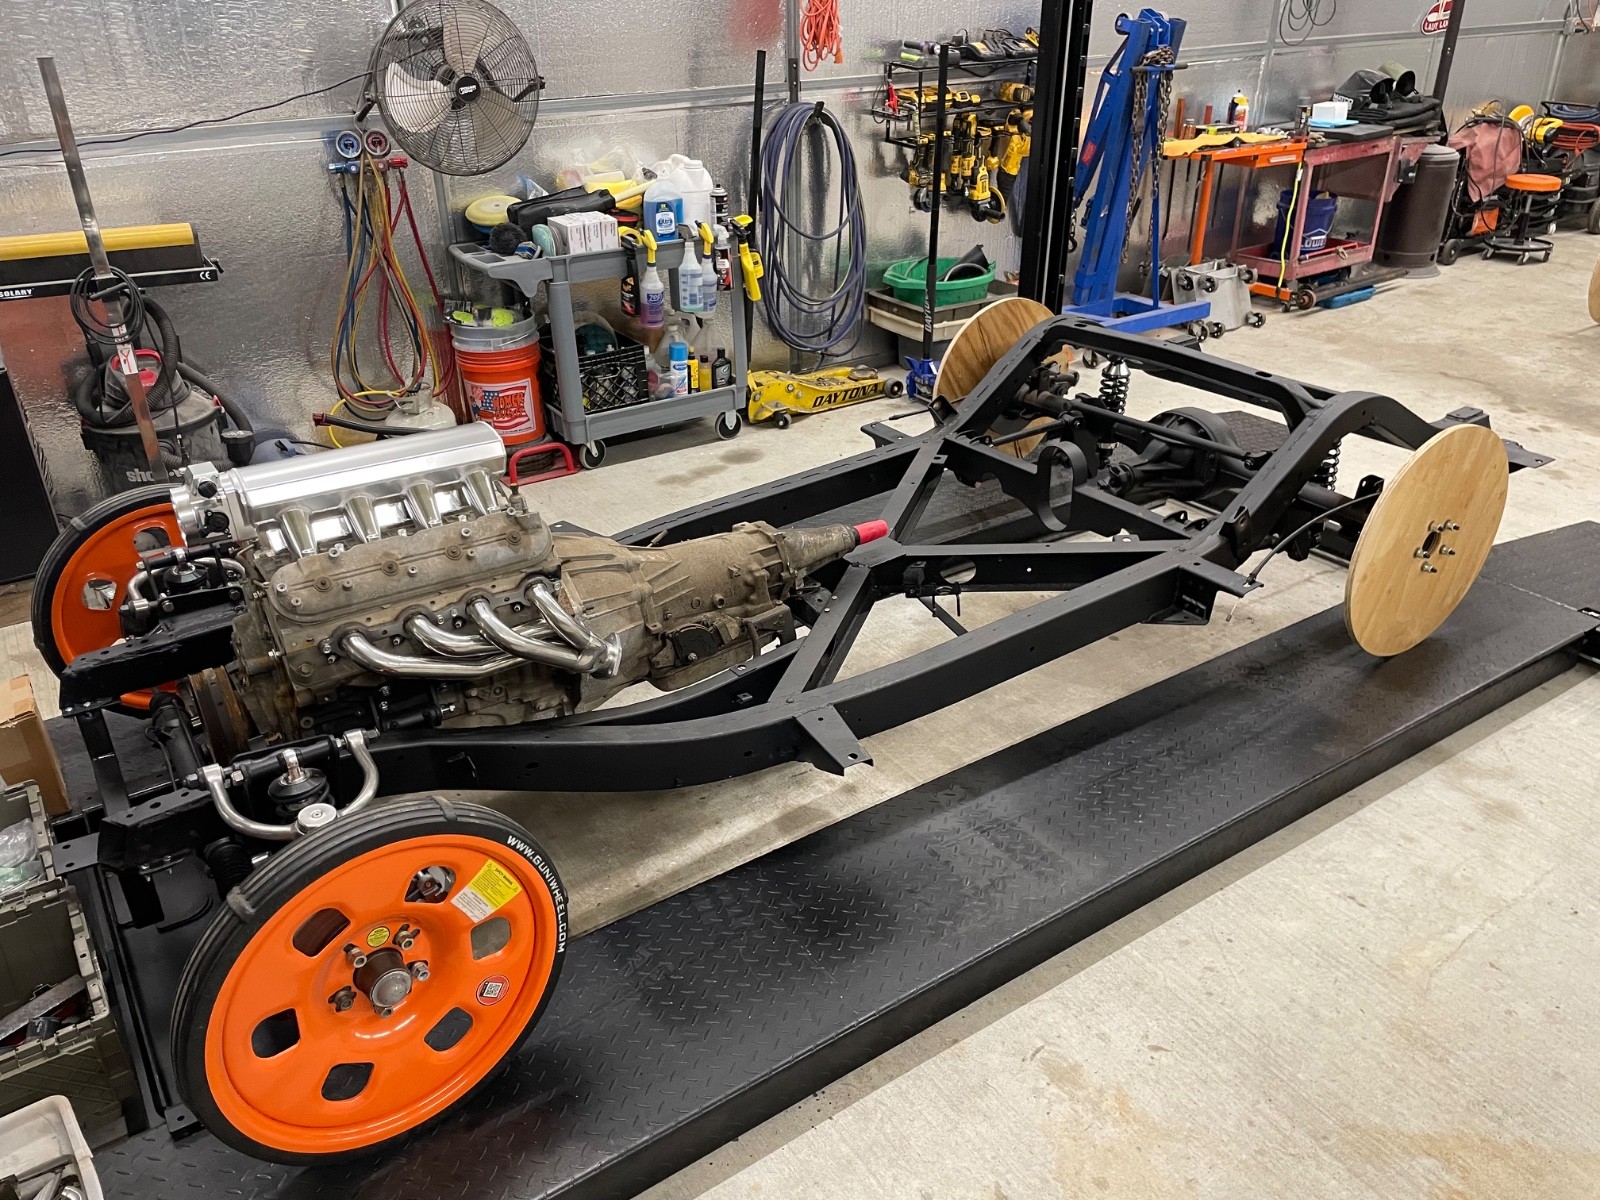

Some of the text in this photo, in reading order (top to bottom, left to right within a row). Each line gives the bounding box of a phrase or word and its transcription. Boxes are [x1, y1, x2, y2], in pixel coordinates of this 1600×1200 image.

[1424, 19, 1449, 31] LADY LU
[199, 271, 212, 280] CE
[924, 288, 932, 333] DAYTO
[812, 383, 879, 408] DAYTONA
[506, 835, 567, 953] WWW.GUNIWHEEL.COM
